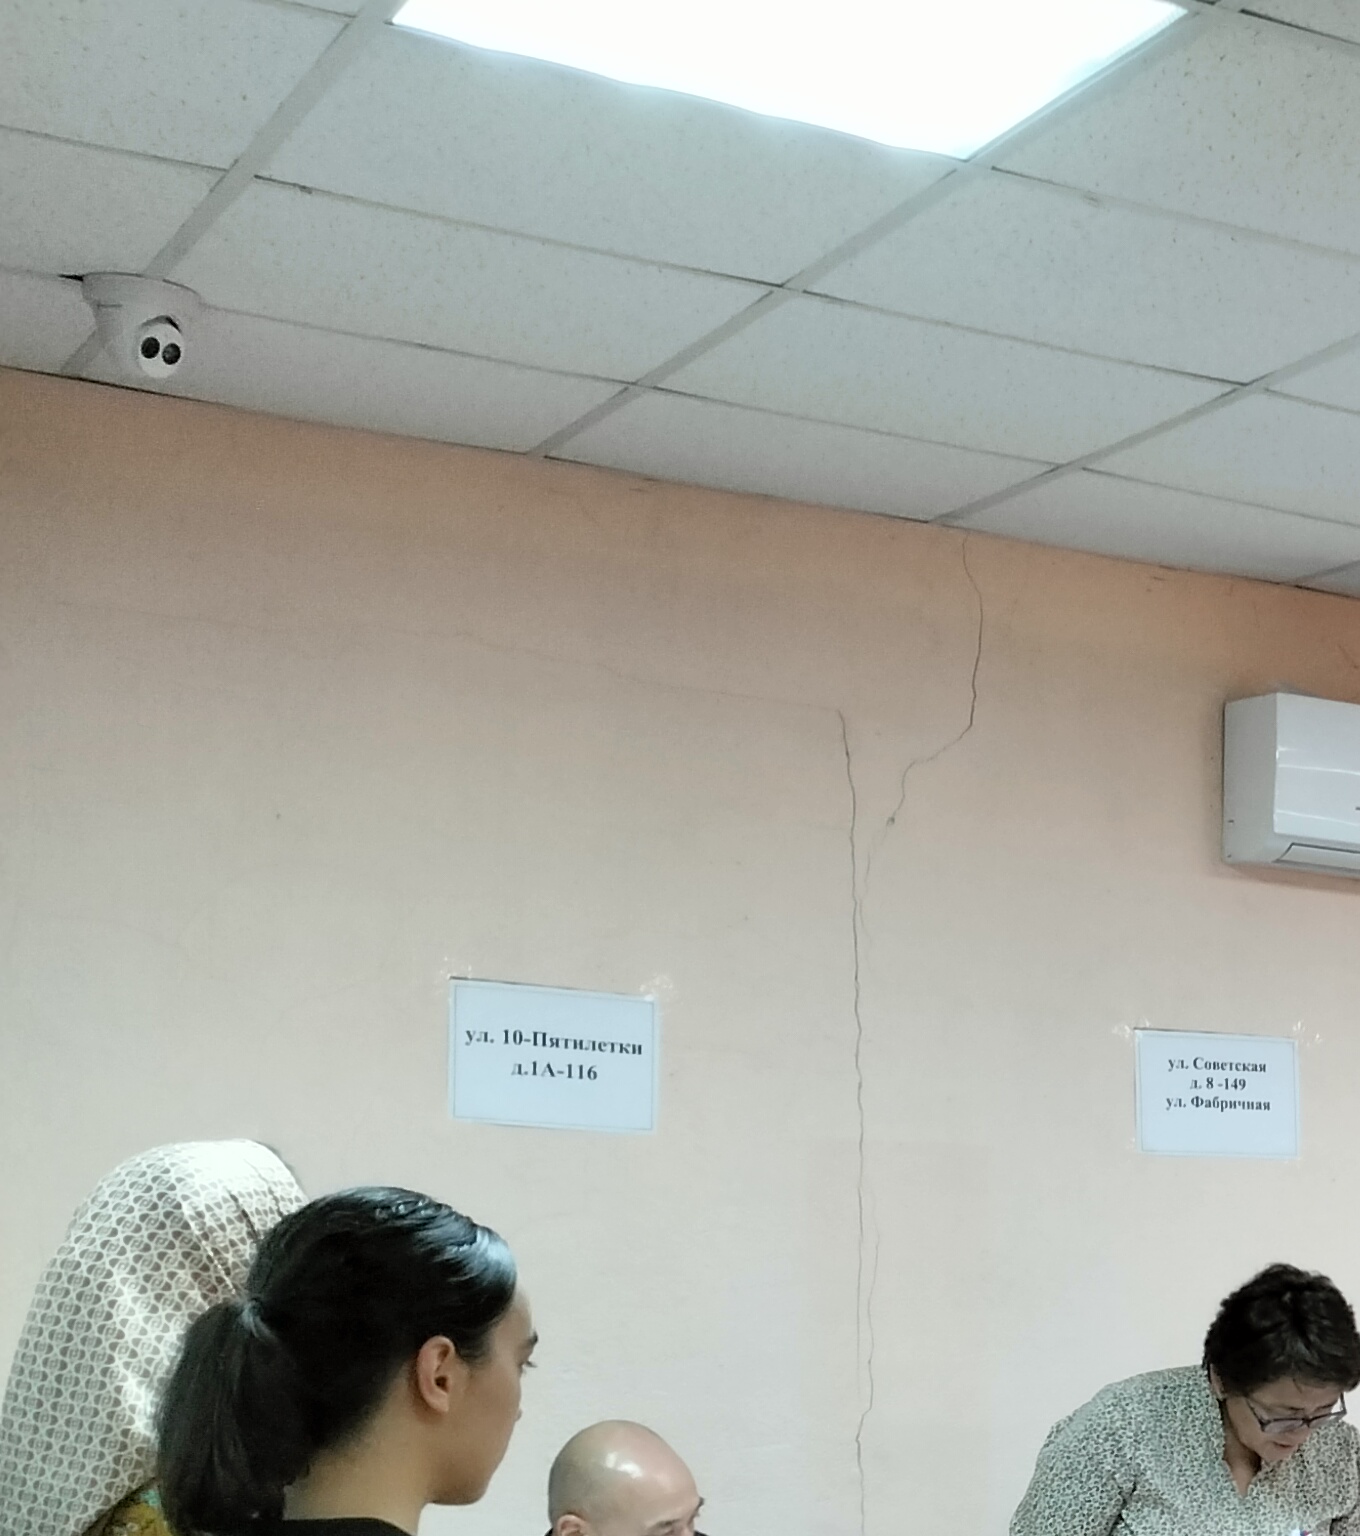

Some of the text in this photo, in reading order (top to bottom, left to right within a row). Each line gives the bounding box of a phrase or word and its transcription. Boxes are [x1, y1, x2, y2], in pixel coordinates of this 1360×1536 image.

[465, 1029, 643, 1056] ул. 10-Пятилетки
[1168, 1056, 1267, 1073] ул. Советская
[1190, 1078, 1203, 1090] д.
[1166, 1096, 1271, 1112] ул. Фабричная
